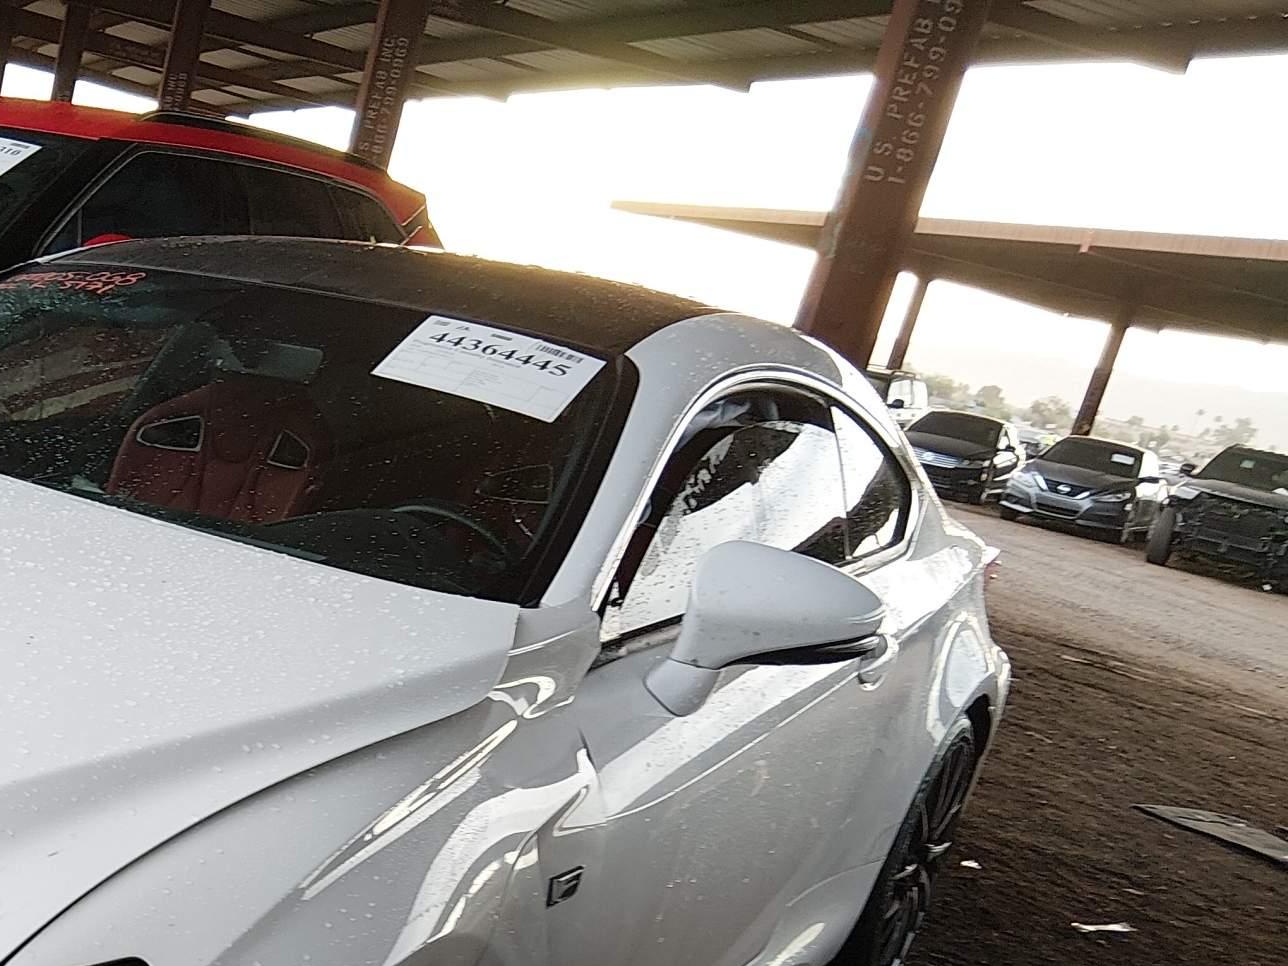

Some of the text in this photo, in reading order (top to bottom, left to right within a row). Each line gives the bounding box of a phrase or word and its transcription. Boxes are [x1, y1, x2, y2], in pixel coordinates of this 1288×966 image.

[864, 165, 885, 183] U
[886, 17, 934, 121] PREFAB
[428, 332, 573, 377] 44364445
